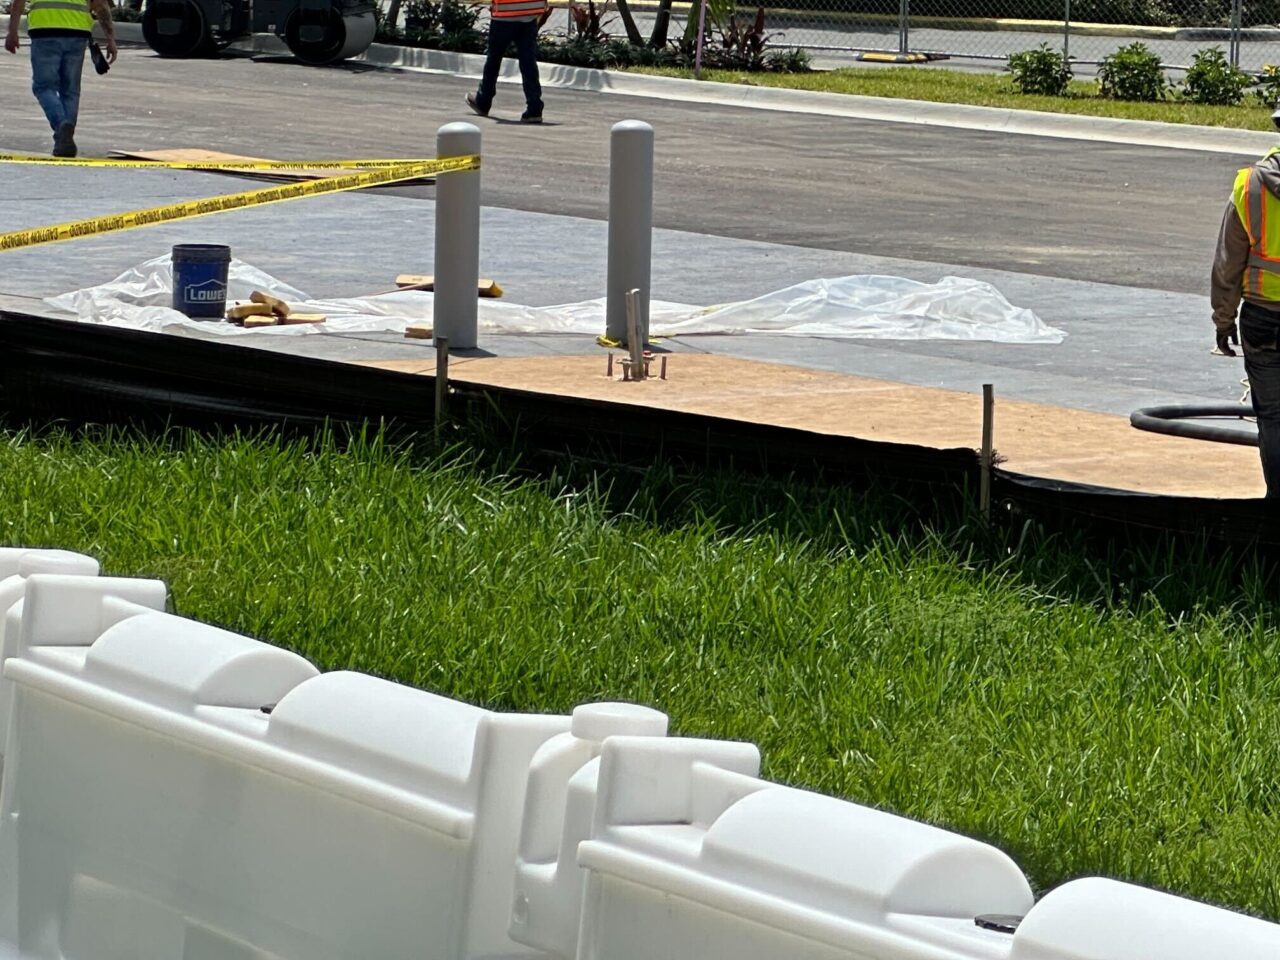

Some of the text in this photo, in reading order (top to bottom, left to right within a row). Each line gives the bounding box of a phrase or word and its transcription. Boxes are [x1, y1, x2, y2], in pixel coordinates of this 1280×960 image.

[69, 220, 96, 238] CUIDADO
[97, 216, 124, 233] CAUTION
[1, 233, 29, 250] CUIDADO
[30, 227, 58, 243] CAUTION
[190, 288, 226, 301] LOWE
